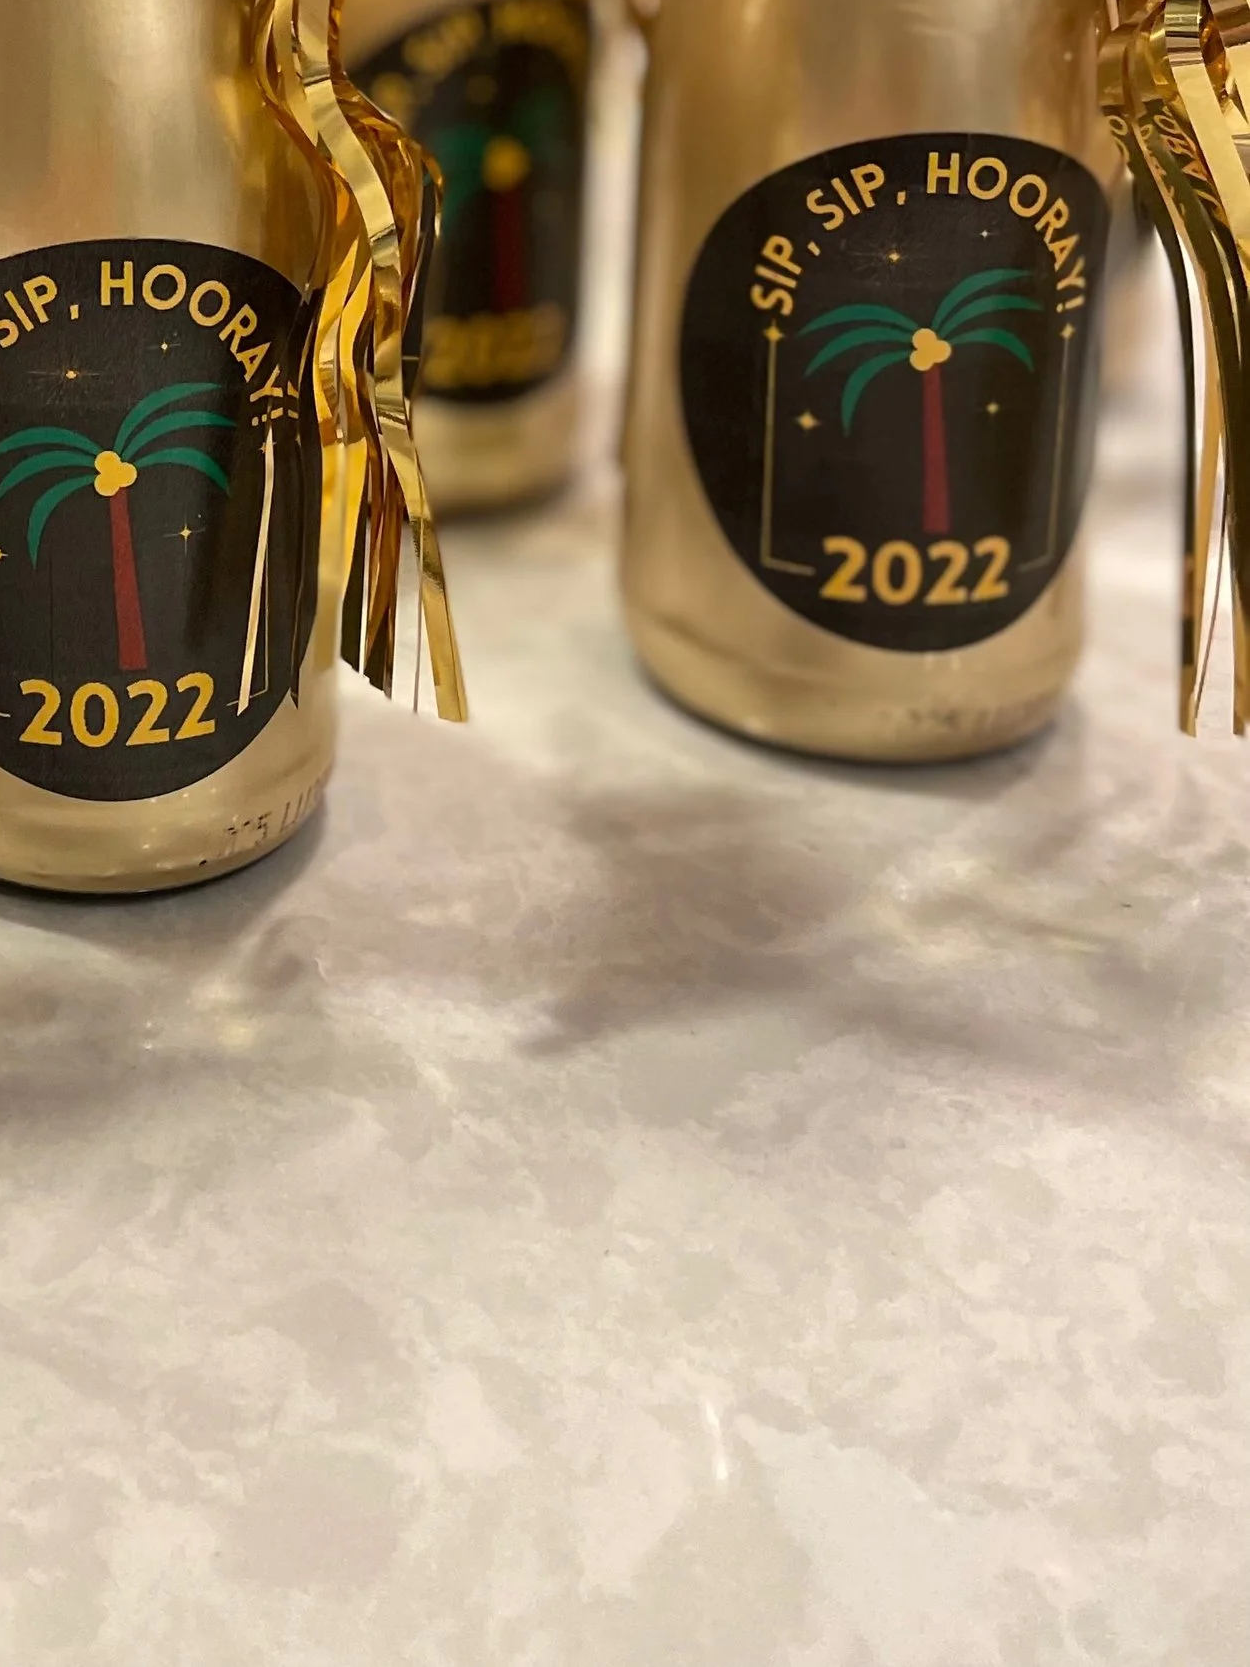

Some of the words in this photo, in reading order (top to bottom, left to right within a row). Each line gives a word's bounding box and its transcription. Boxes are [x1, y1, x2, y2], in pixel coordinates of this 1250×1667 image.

[751, 235, 821, 316] SIP,
[806, 163, 906, 231] SIP,
[926, 151, 1086, 313] HOORAY!
[820, 536, 1011, 605] 2022
[19, 671, 216, 748] 2022
